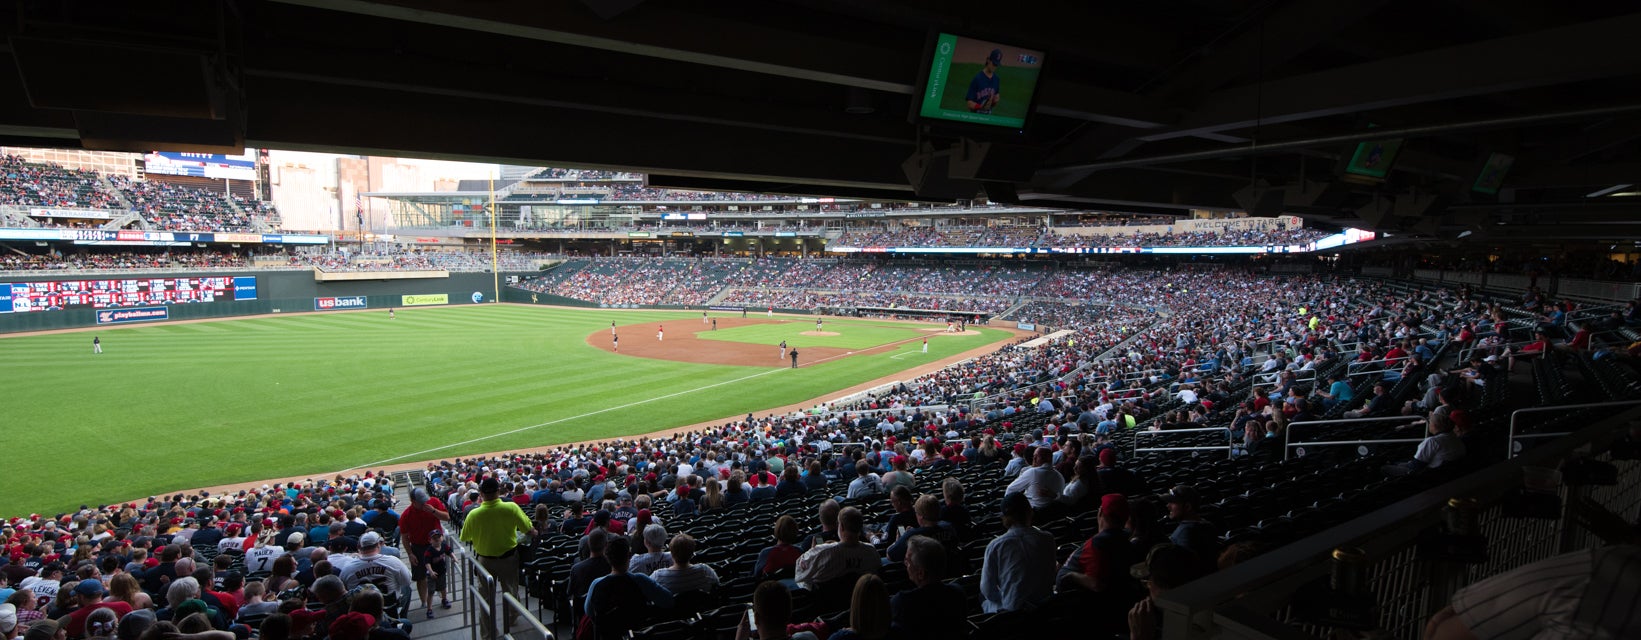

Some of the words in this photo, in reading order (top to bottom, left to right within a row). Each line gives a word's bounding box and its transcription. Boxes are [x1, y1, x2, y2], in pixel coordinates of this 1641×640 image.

[1194, 220, 1241, 228] WELCOME
[1257, 217, 1291, 226] TARGET
[254, 549, 274, 557] MAUER
[258, 557, 268, 570] 7
[355, 566, 387, 579] BUXTON
